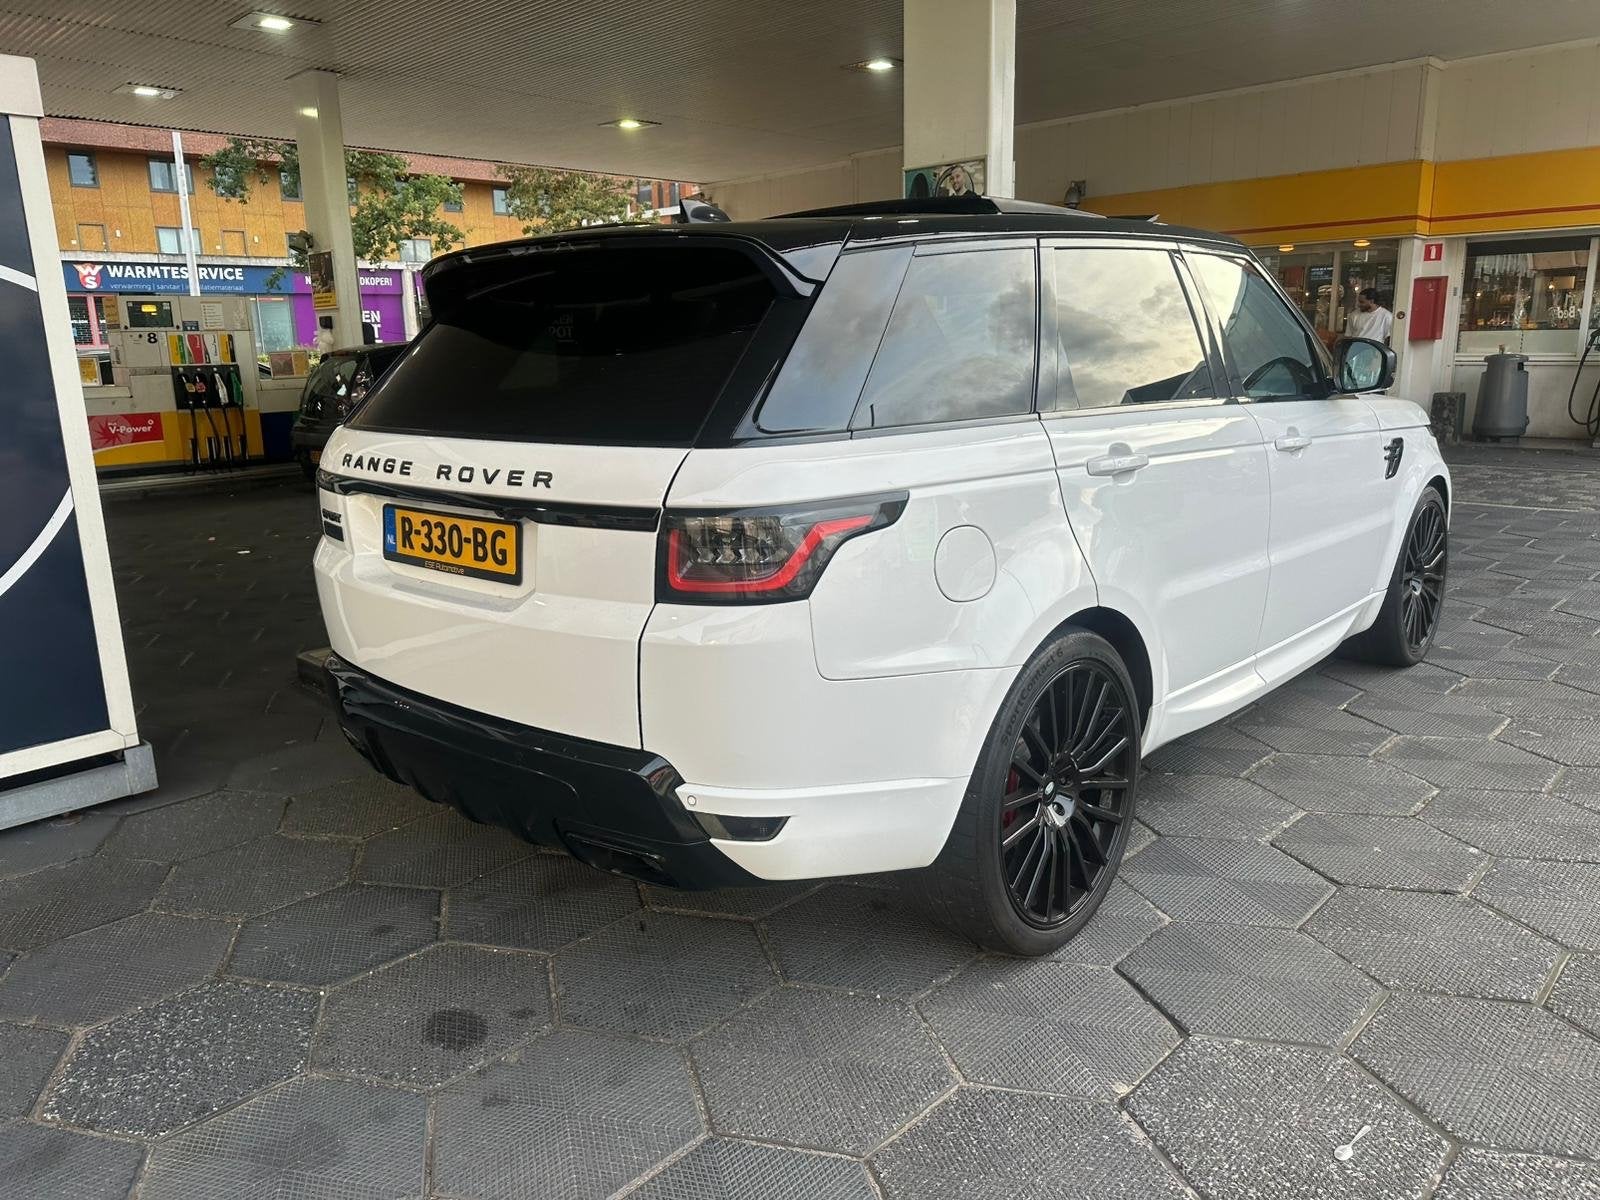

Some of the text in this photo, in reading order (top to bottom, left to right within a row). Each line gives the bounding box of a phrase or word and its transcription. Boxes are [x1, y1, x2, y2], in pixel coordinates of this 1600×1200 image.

[107, 265, 244, 281] WARMTESRVICE
[147, 332, 158, 344] 8
[108, 425, 153, 434] V-Power
[342, 453, 553, 489] RANGE ROVER
[400, 515, 508, 567] R-330-BG
